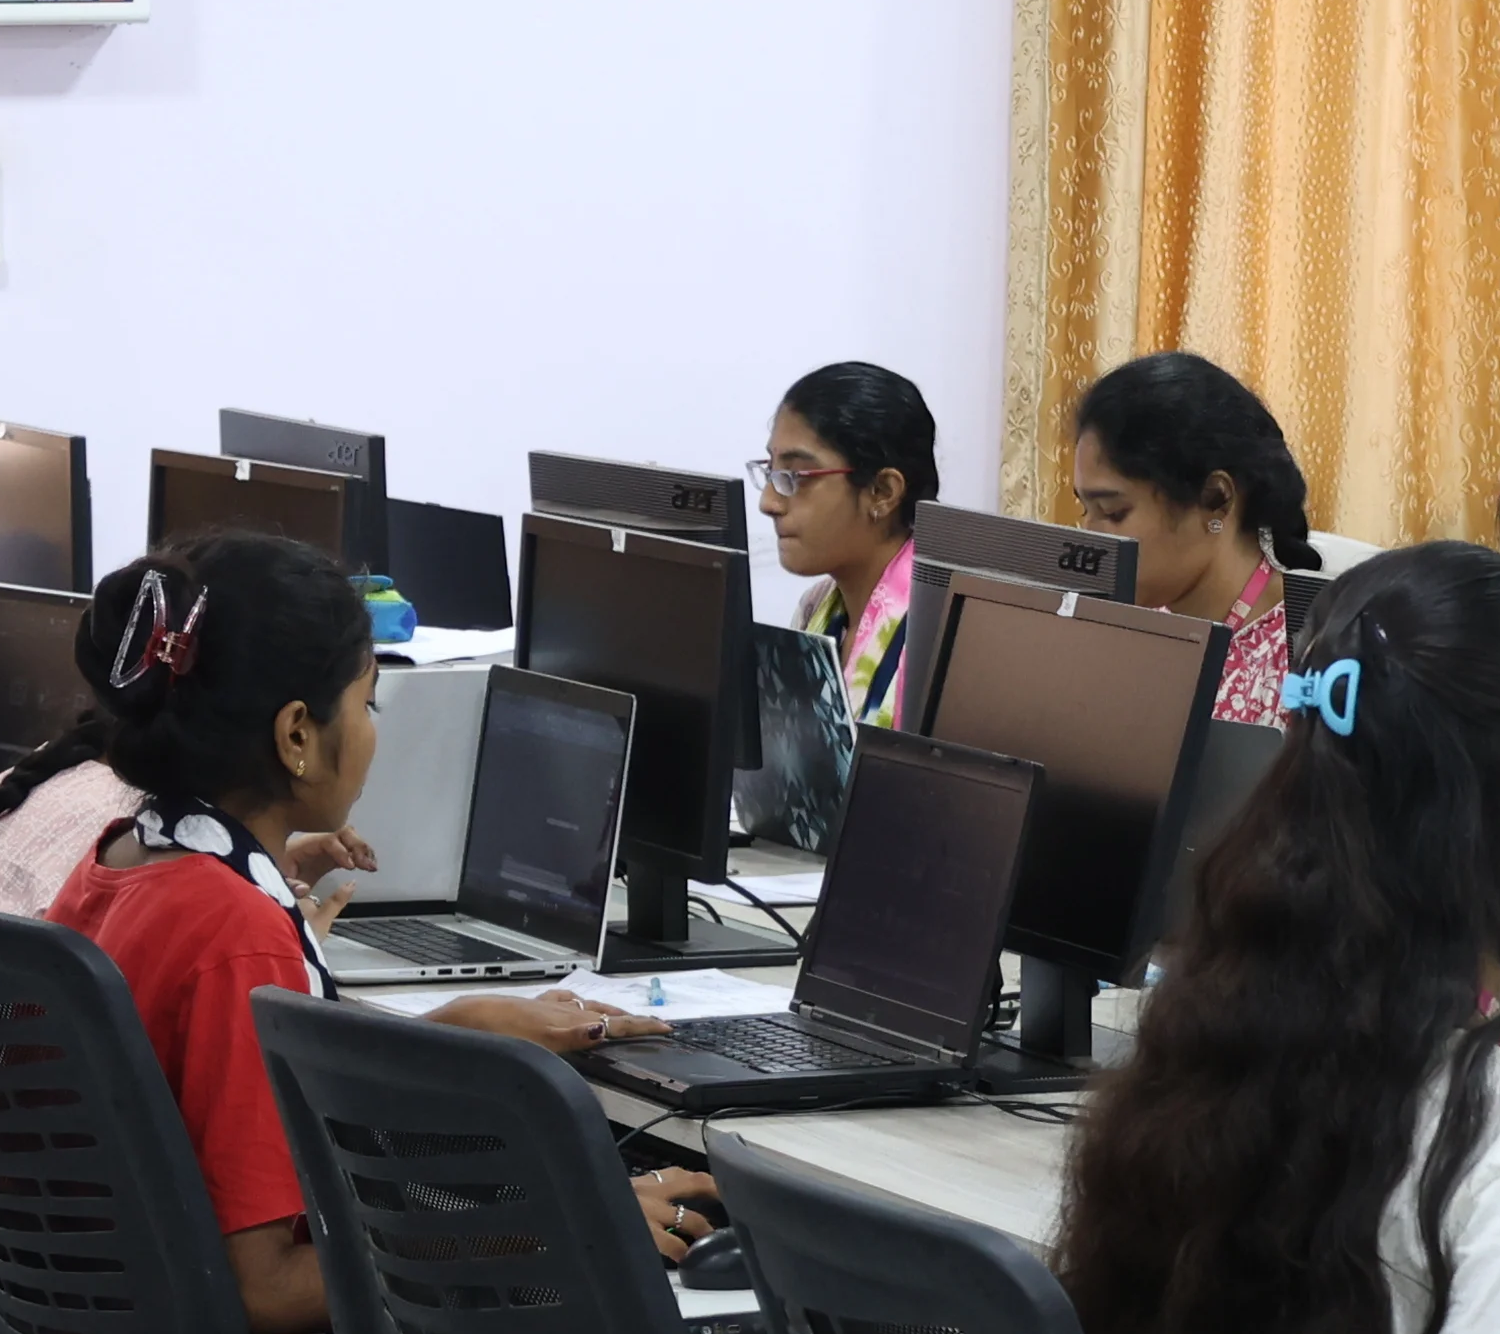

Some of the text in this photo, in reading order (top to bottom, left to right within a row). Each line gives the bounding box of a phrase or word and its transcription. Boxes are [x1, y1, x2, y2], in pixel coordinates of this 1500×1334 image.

[327, 440, 362, 467] acer
[672, 484, 717, 514] acer
[1059, 542, 1108, 575] acer
